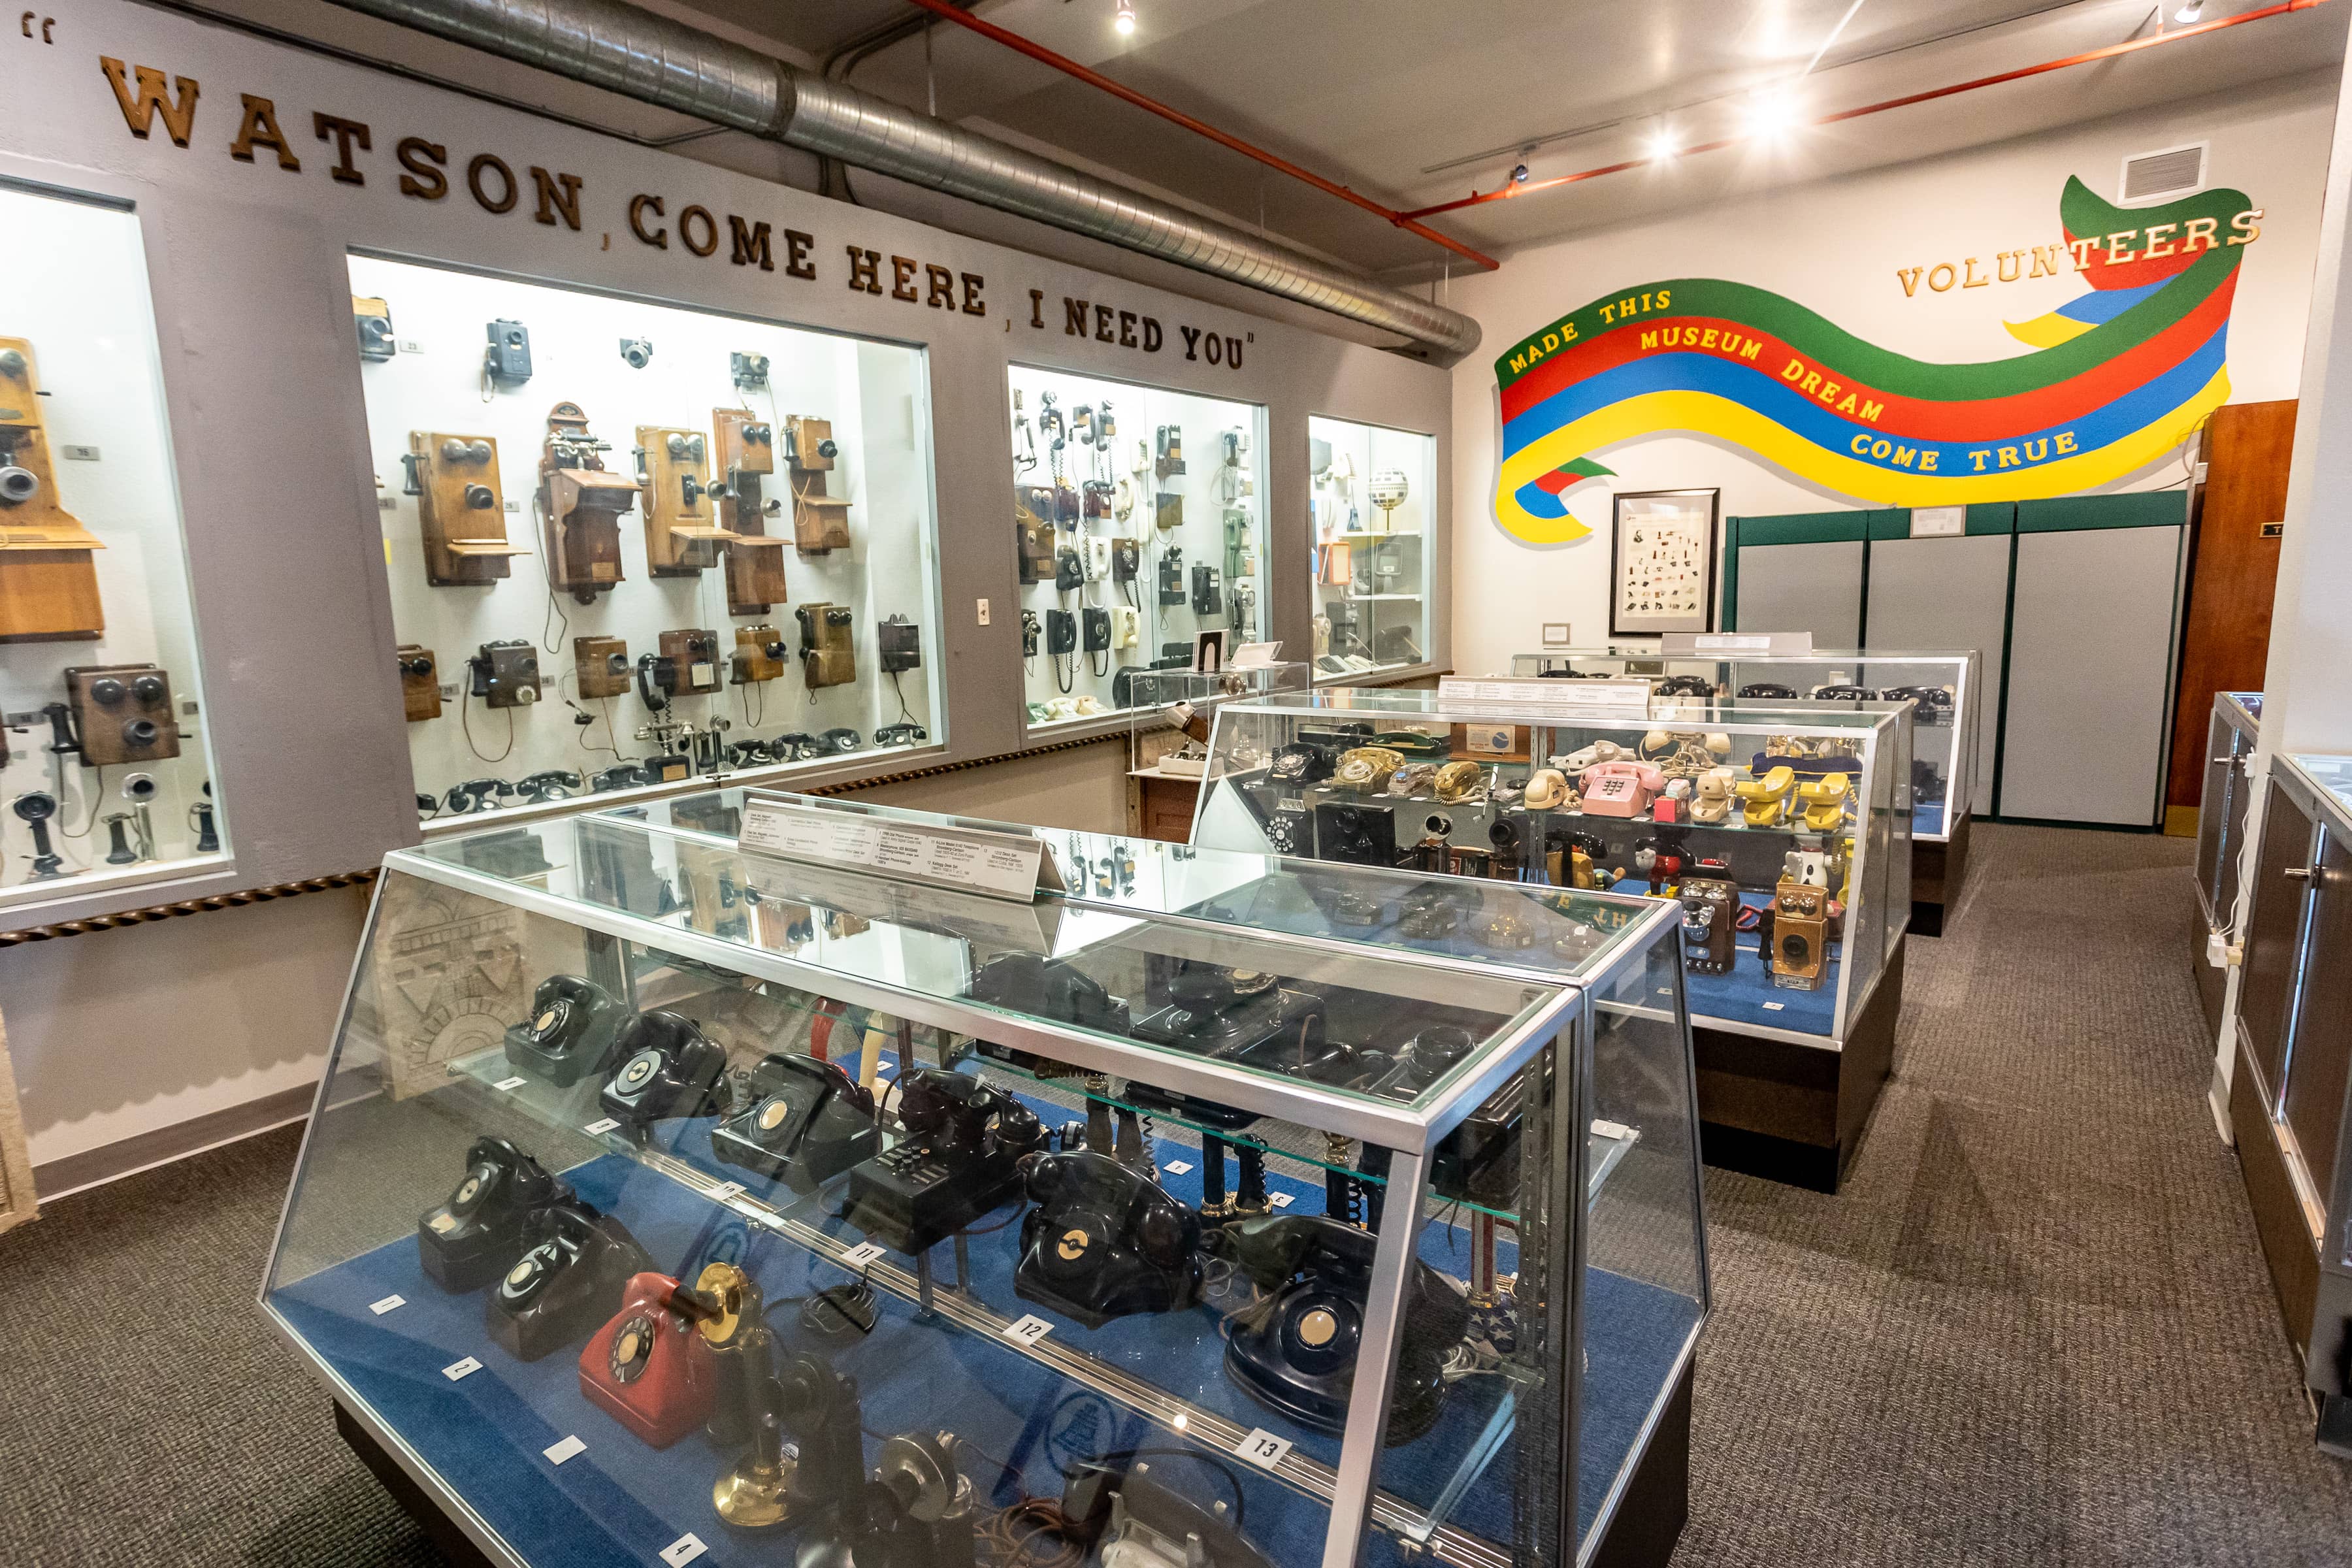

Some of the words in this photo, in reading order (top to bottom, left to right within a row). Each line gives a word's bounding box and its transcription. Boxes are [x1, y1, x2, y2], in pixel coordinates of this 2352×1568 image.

[1897, 208, 2266, 297] VOLUNTEERS
[630, 193, 817, 281] COME
[1030, 288, 1045, 329] I
[1064, 296, 1163, 353] NEED
[1509, 322, 1579, 374] MADE
[1599, 289, 1671, 324] THIS
[1641, 327, 1763, 361] MUSEUM
[1781, 359, 1885, 423] DREAM
[1850, 434, 1940, 472] COME
[1969, 431, 2079, 472] TRUE
[856, 1248, 875, 1259] 11
[1020, 1322, 1042, 1337] 12
[454, 1364, 470, 1373] 2
[1254, 1439, 1279, 1458] 13
[676, 1543, 692, 1556] 4
